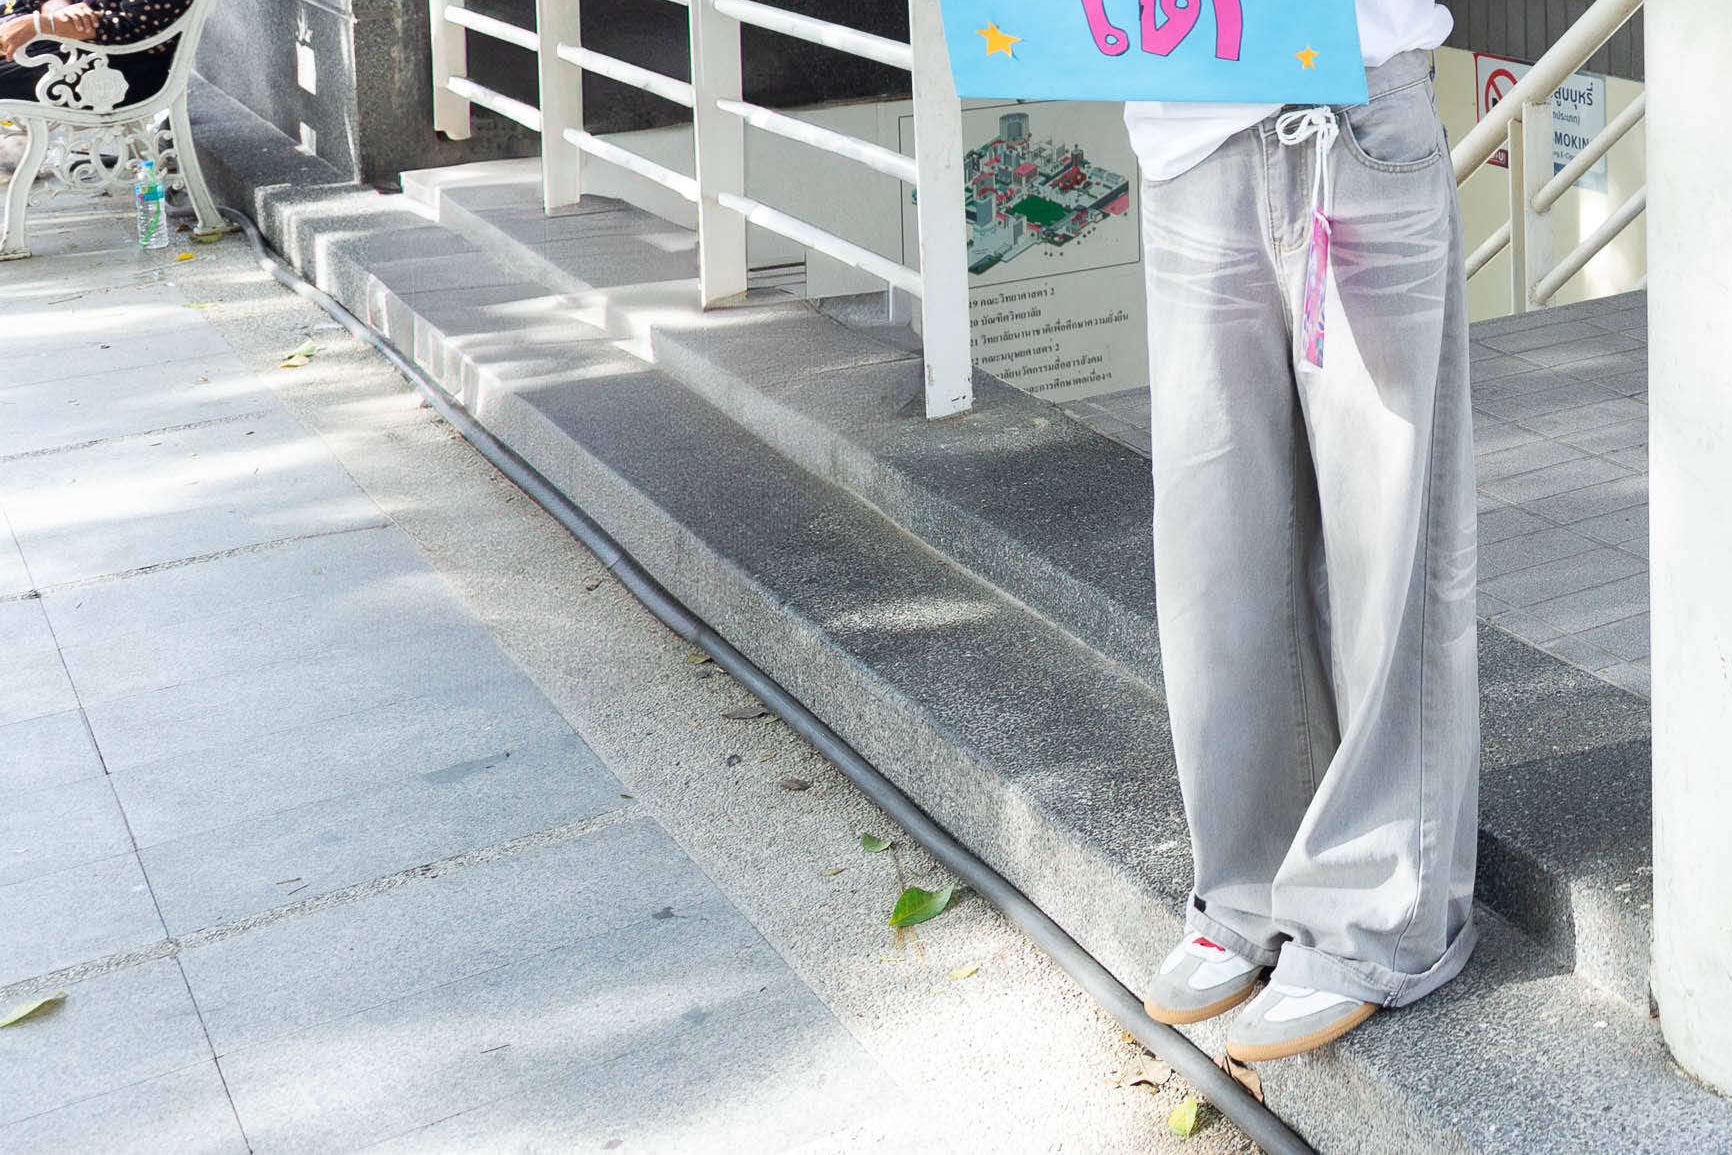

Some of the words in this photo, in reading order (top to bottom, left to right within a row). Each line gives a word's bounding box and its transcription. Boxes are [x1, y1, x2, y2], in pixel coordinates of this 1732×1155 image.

[1551, 81, 1593, 110] สูบบุหรี่
[1553, 130, 1592, 150] MOKIN
